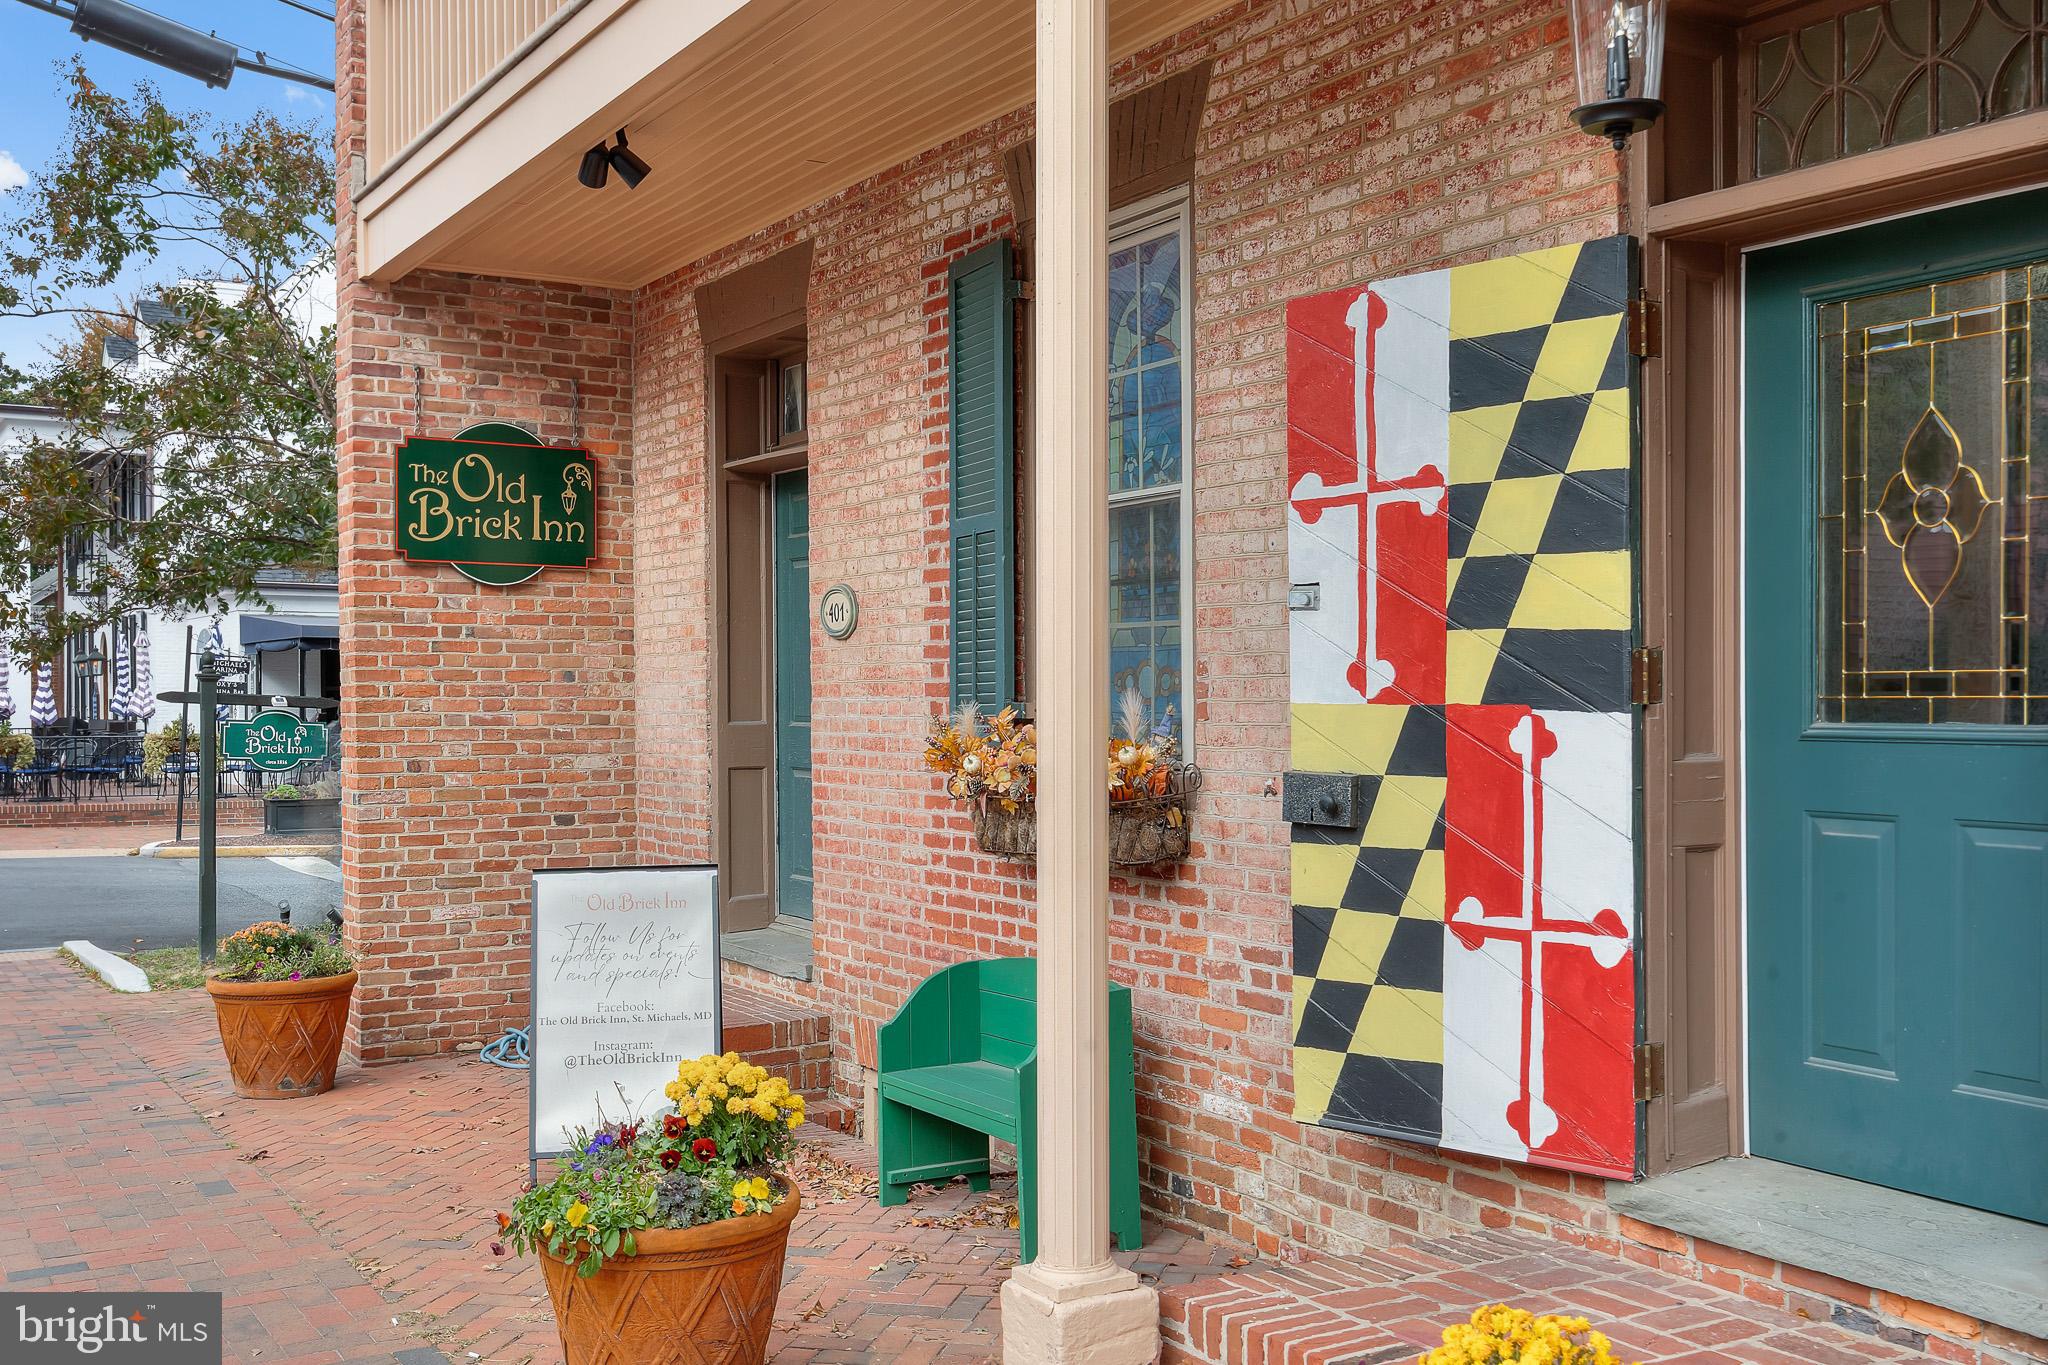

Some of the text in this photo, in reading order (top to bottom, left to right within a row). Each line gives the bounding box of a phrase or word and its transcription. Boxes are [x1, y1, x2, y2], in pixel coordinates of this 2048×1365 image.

[408, 453, 527, 504] The Old
[408, 487, 585, 543] Brick Inn
[828, 602, 845, 623] 401
[245, 725, 287, 742] The Old
[245, 736, 285, 755] Brick
[586, 893, 615, 911] Old
[618, 892, 661, 912] Brick
[665, 891, 688, 909] Inn
[564, 921, 687, 954] Follow Us for
[551, 944, 616, 981] updates
[649, 941, 701, 966] events
[566, 958, 683, 998] and specials!
[597, 1000, 655, 1013] Facebook:
[539, 1011, 712, 1026] The Old Brick Inn, St. Michaels, MD
[593, 1041, 654, 1054] Instagram:
[565, 1052, 683, 1069] @TheOldBrickInn
